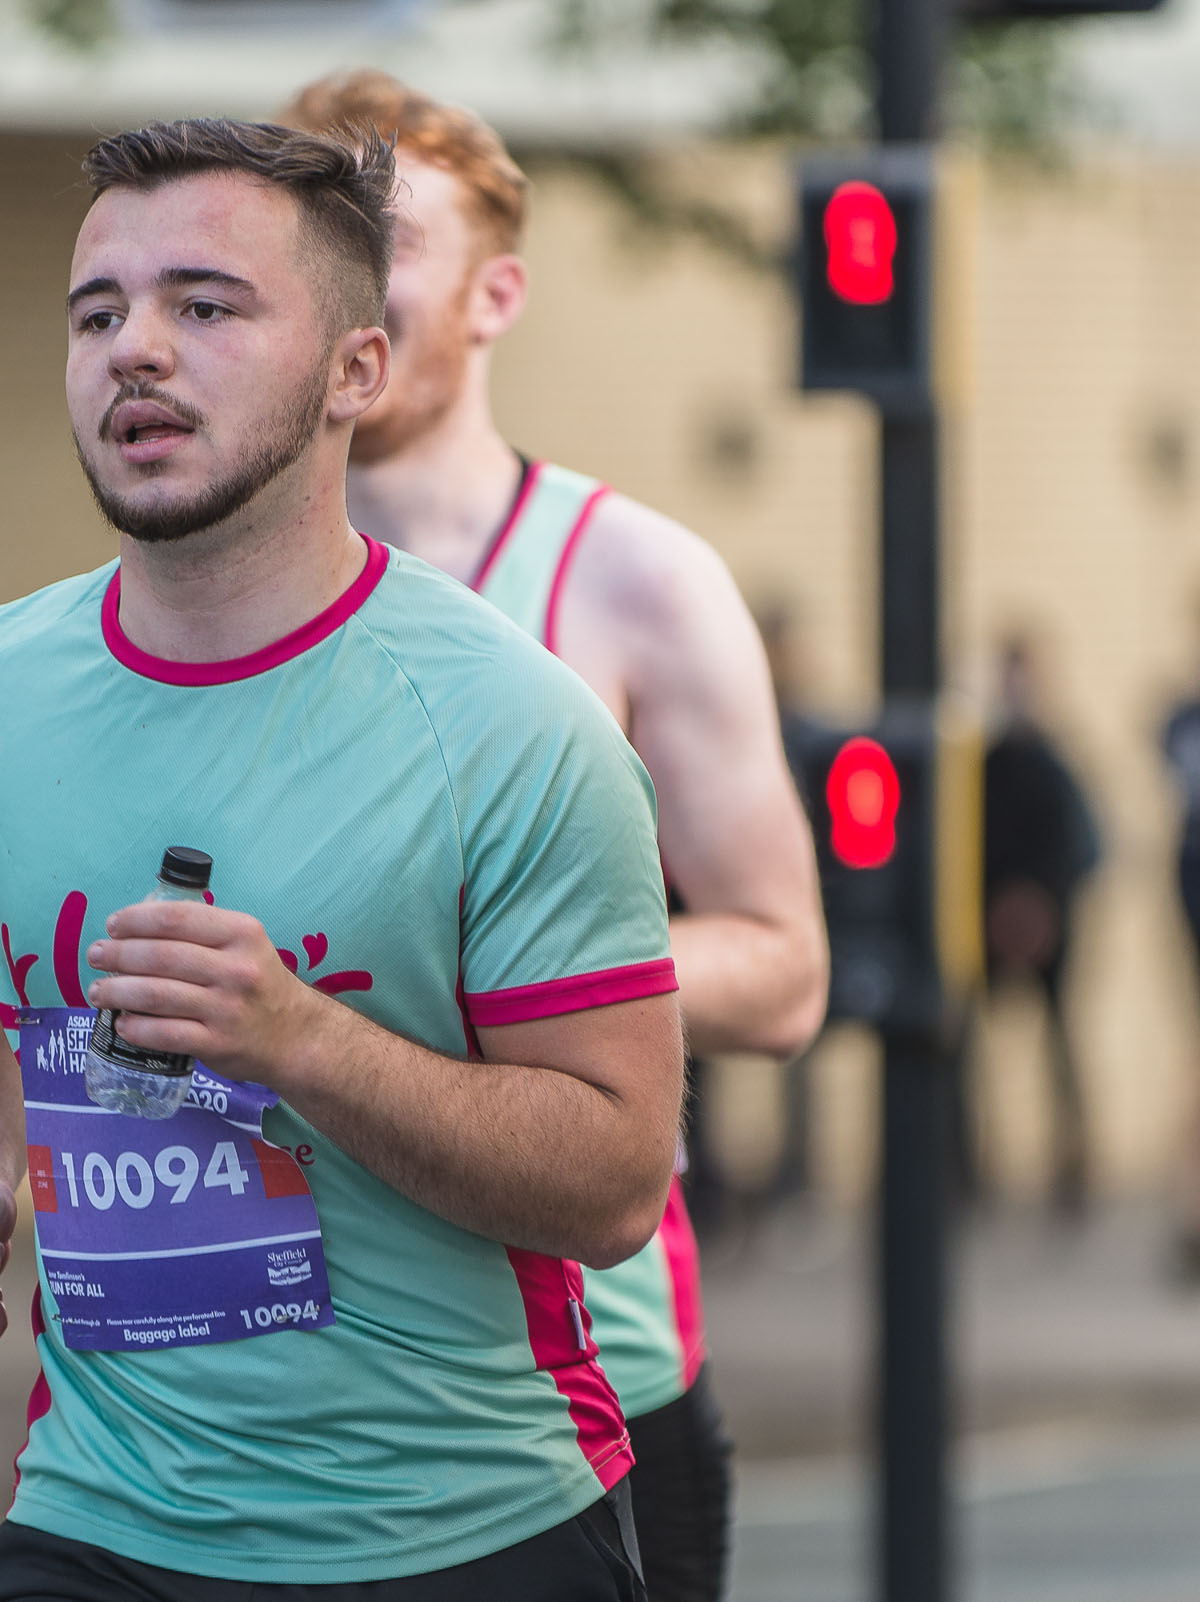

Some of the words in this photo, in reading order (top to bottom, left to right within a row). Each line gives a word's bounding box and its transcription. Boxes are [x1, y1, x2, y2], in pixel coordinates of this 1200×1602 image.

[67, 1015, 90, 1029] ASDA
[186, 1088, 228, 1114] 020
[61, 1141, 250, 1211] 10094
[267, 1247, 307, 1263] Sheffield
[64, 1282, 85, 1297] FOR
[86, 1283, 105, 1298] ALL
[173, 1314, 183, 1323] the
[183, 1310, 214, 1323] perforated
[240, 1299, 319, 1330] 10094
[123, 1328, 177, 1344] Baggage
[178, 1322, 211, 1339] label
